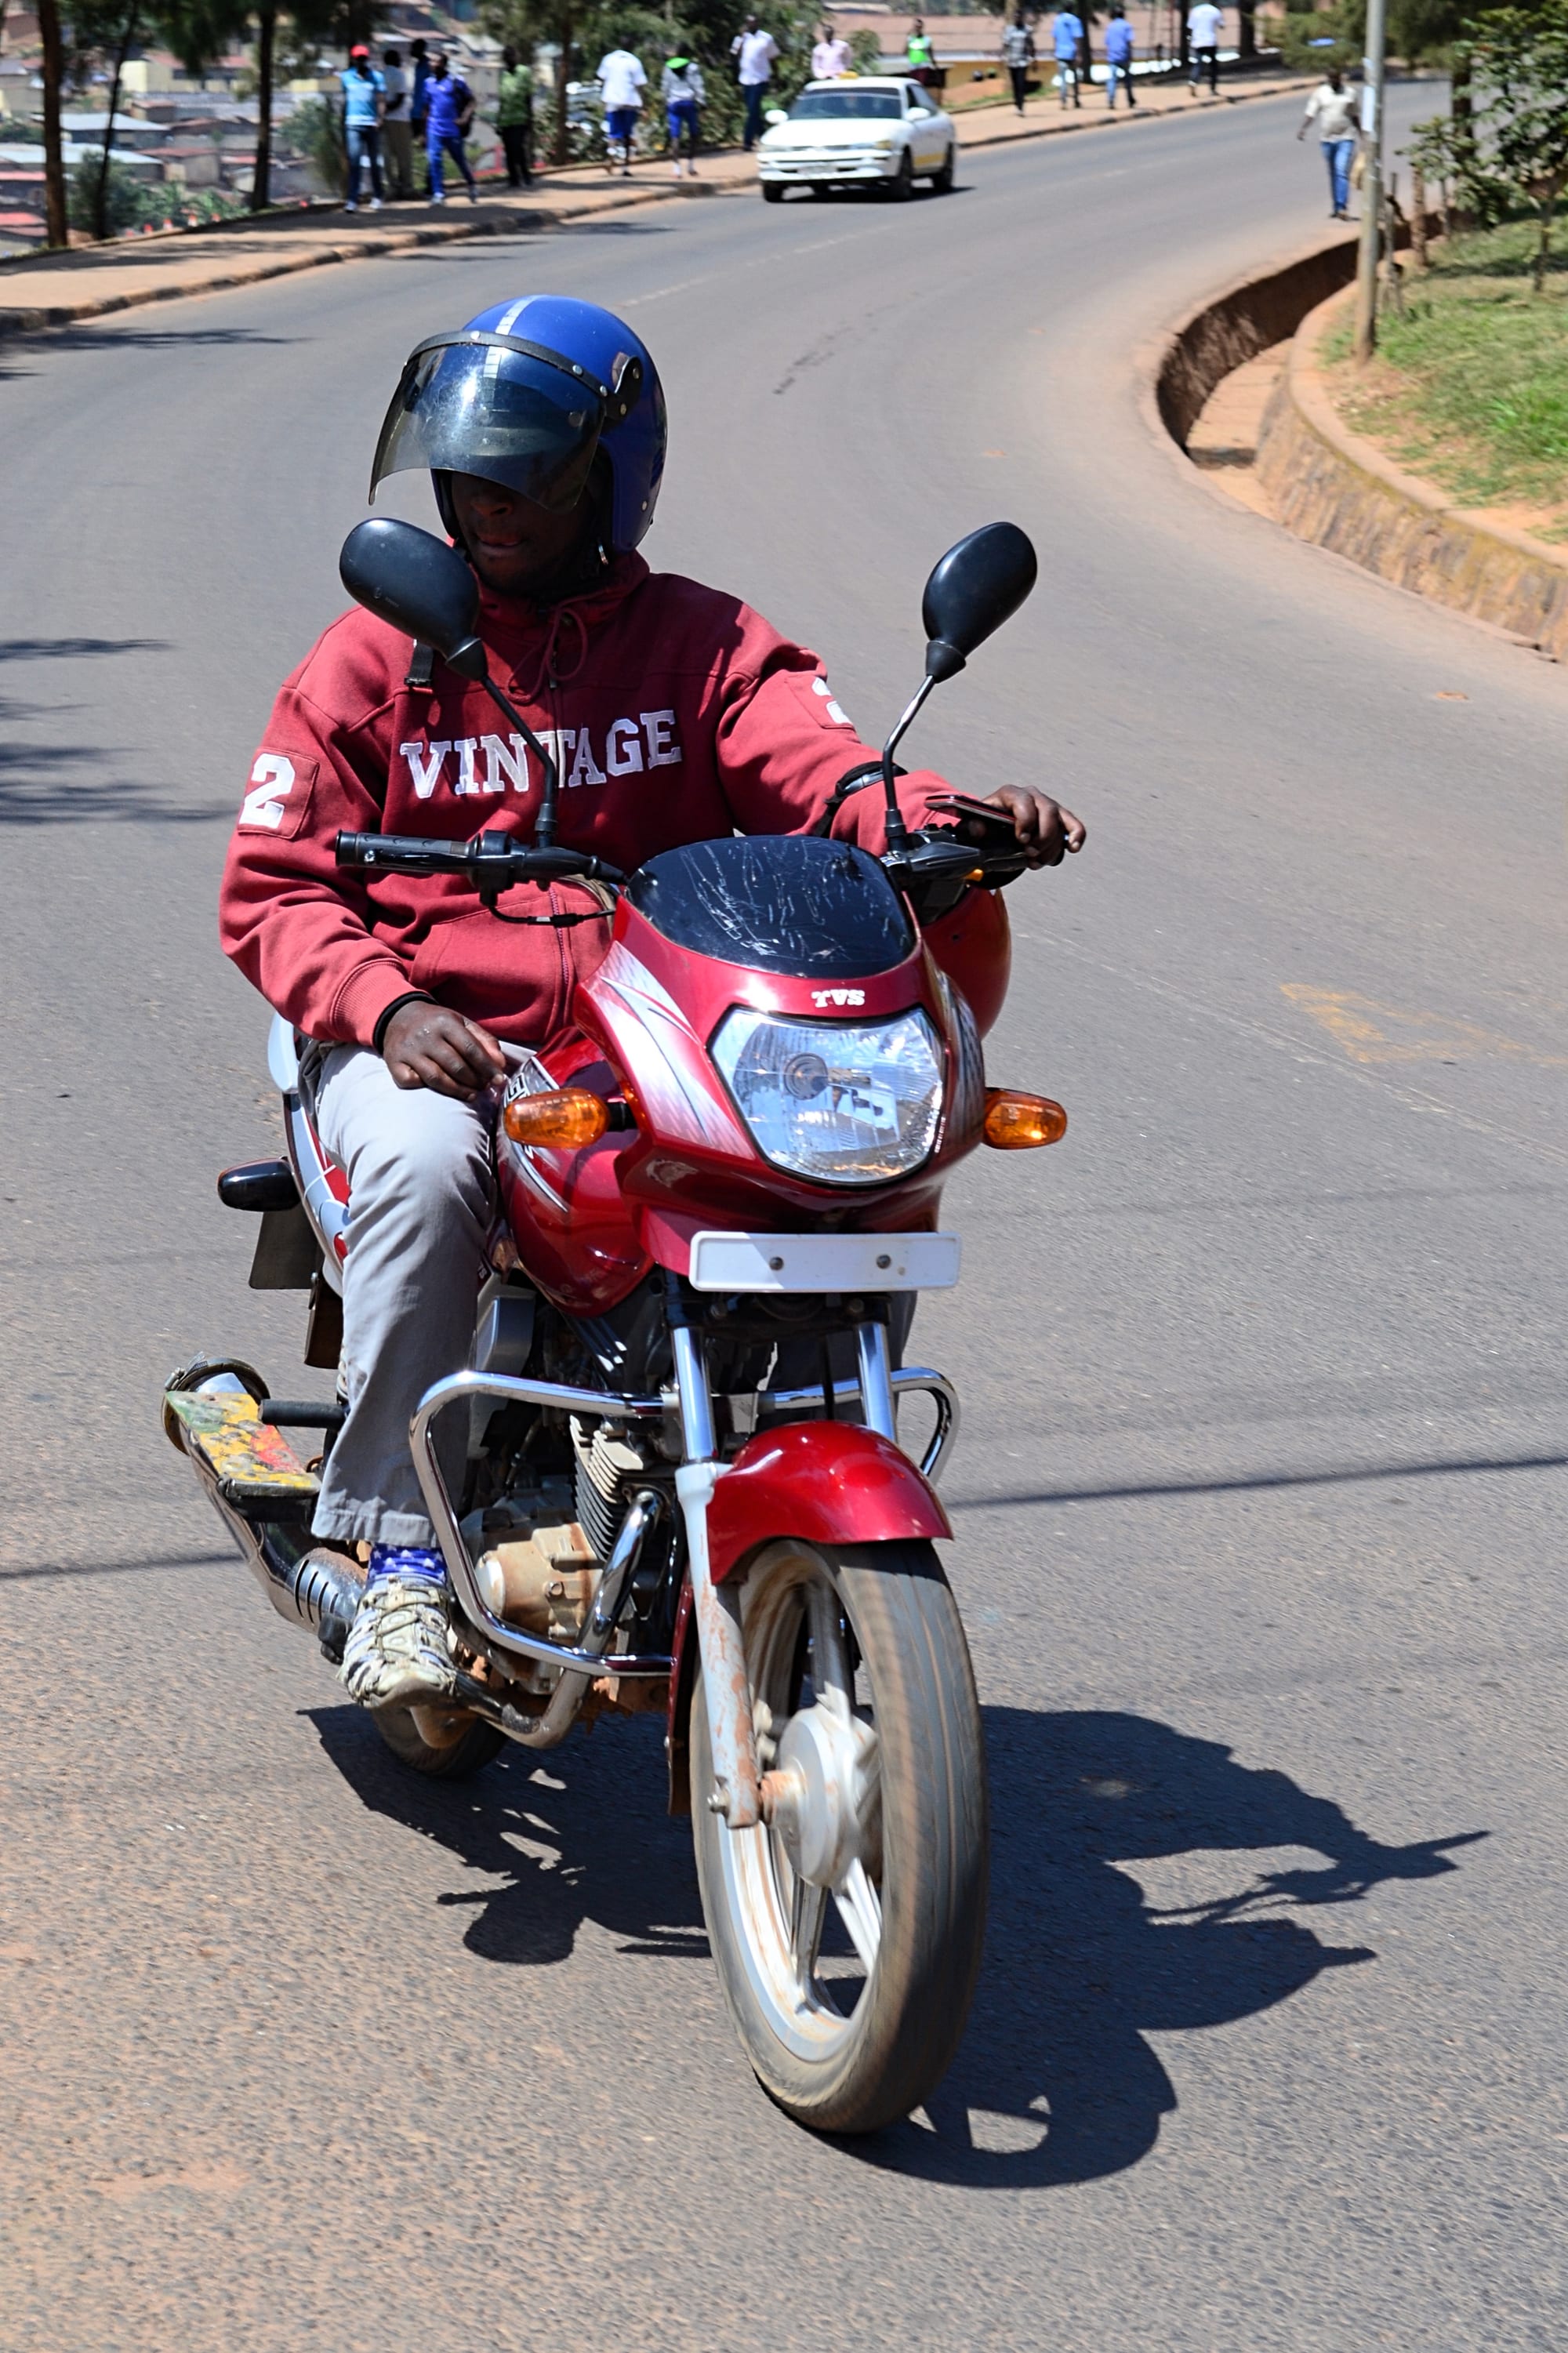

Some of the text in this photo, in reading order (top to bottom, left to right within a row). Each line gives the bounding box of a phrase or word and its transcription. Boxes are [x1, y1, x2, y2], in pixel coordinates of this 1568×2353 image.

[238, 753, 296, 829] 2
[399, 710, 682, 799] VINTAGE
[811, 989, 866, 1008] TVS
